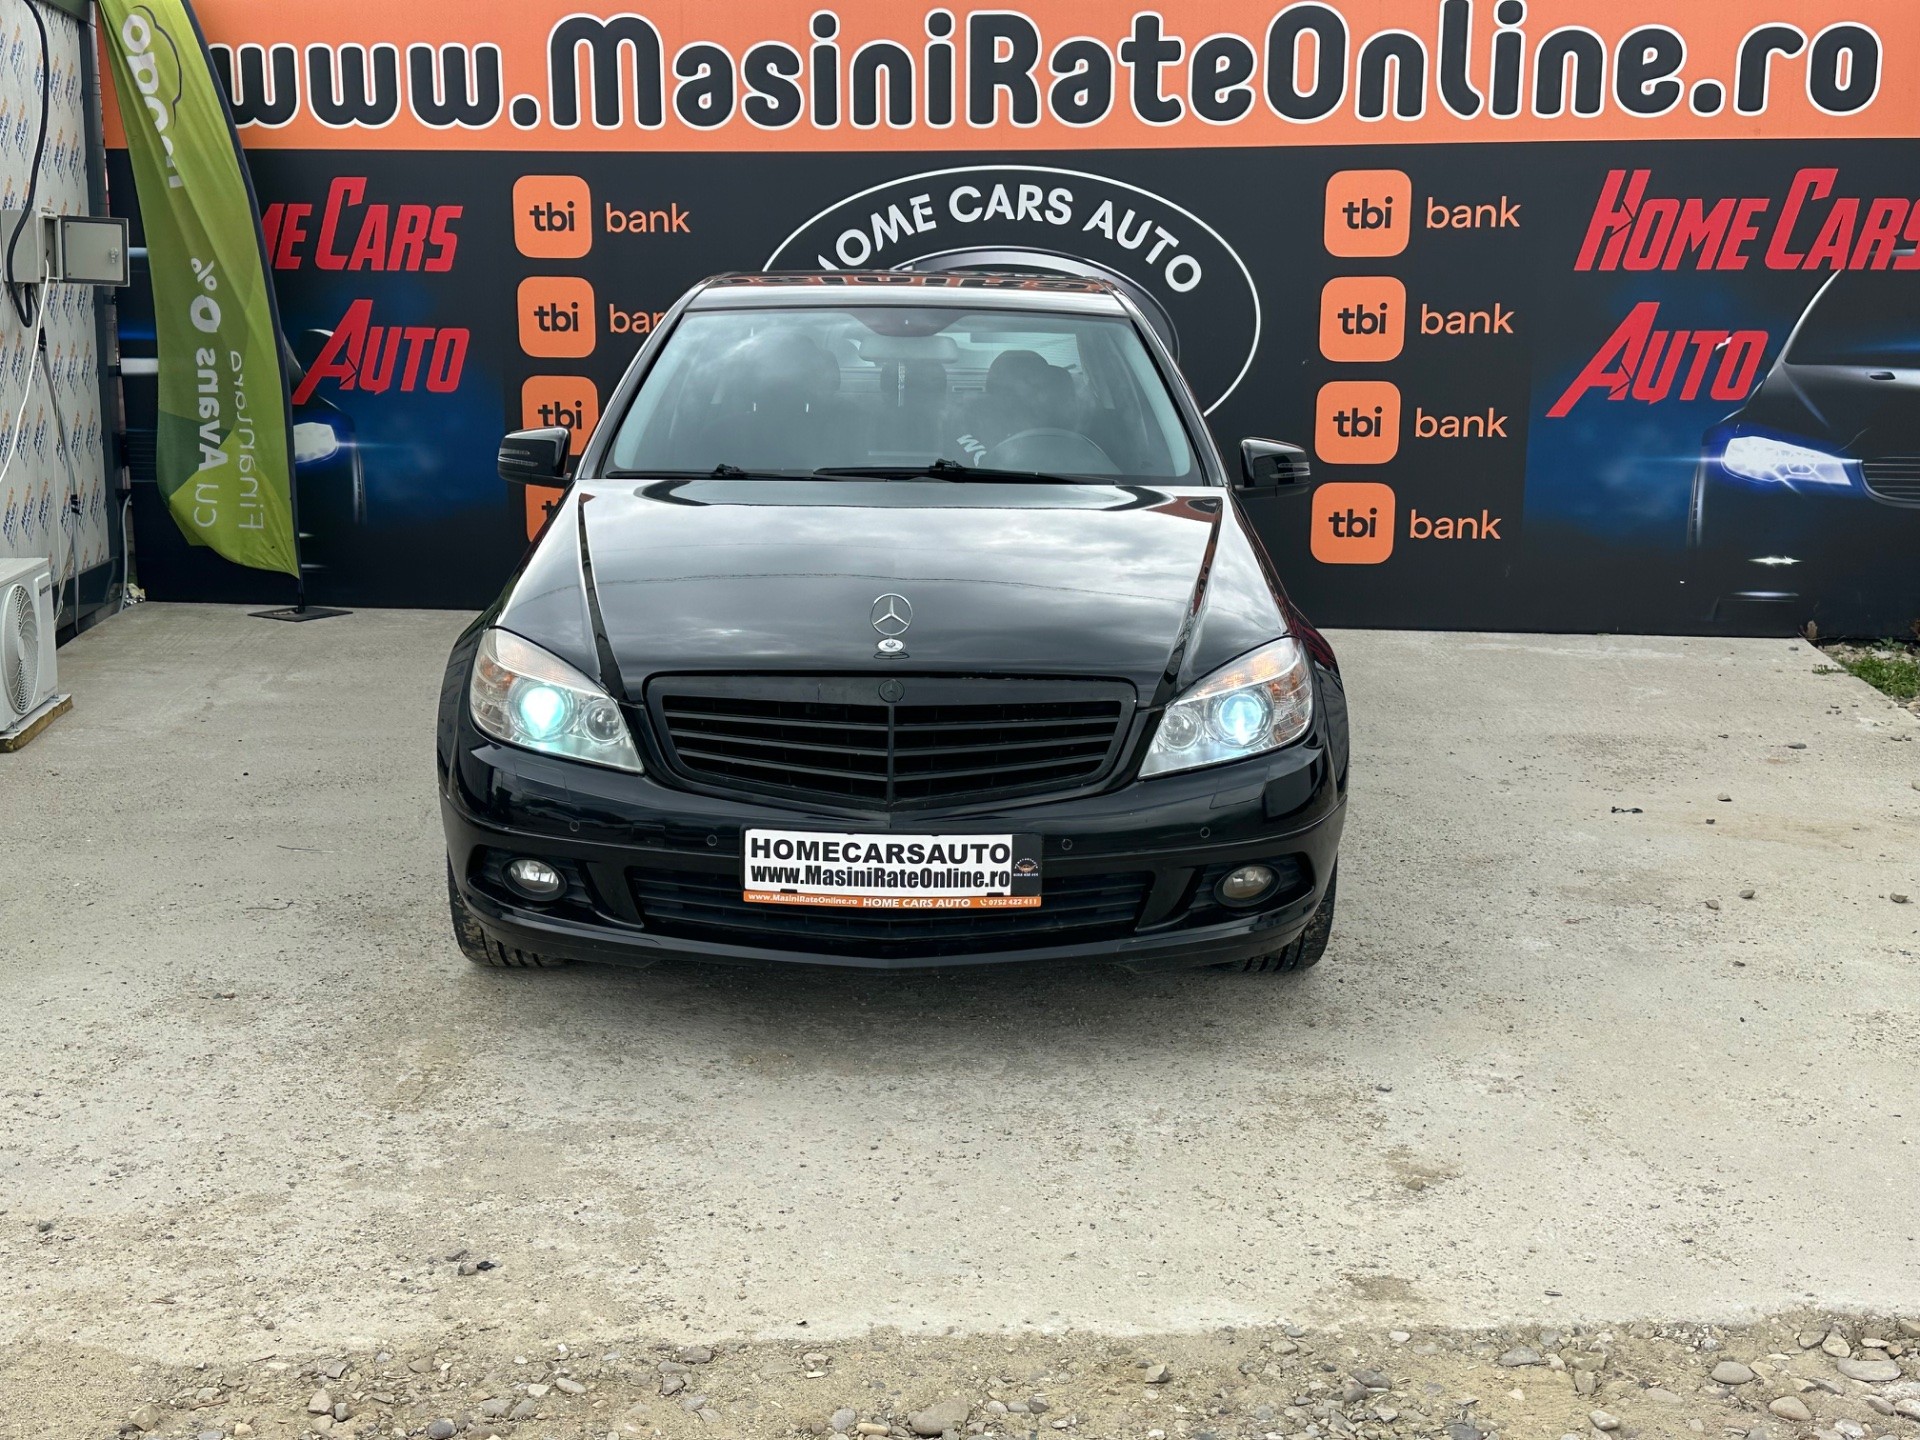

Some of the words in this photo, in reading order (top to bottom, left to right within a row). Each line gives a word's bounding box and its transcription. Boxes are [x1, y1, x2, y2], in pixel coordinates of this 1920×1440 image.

[314, 177, 464, 272] CARS
[529, 201, 575, 232] tbi
[605, 202, 692, 233] bank
[1342, 196, 1394, 229] tbi
[1426, 195, 1522, 229] bank
[1573, 169, 1770, 271] HOME
[817, 193, 938, 271] OME
[948, 184, 1074, 225] CARS
[1082, 200, 1203, 293] AUTO
[533, 301, 579, 333] tbi
[609, 303, 666, 334] ba
[1337, 302, 1388, 335] tbi
[1420, 302, 1516, 335] bank
[290, 299, 471, 406] AUTO
[1545, 302, 1769, 418] AUTO
[537, 400, 583, 430] tbi
[1333, 405, 1383, 438] tbi
[1414, 407, 1509, 438] bank
[1328, 507, 1378, 538] tbi
[1409, 509, 1502, 540] bank
[750, 837, 1011, 865] HOMECARSAUTO
[750, 865, 1011, 888] www.MasiniRateOnline.ro
[863, 898, 900, 907] HOME
[902, 898, 934, 908] CARS
[936, 898, 971, 908] AUTO
